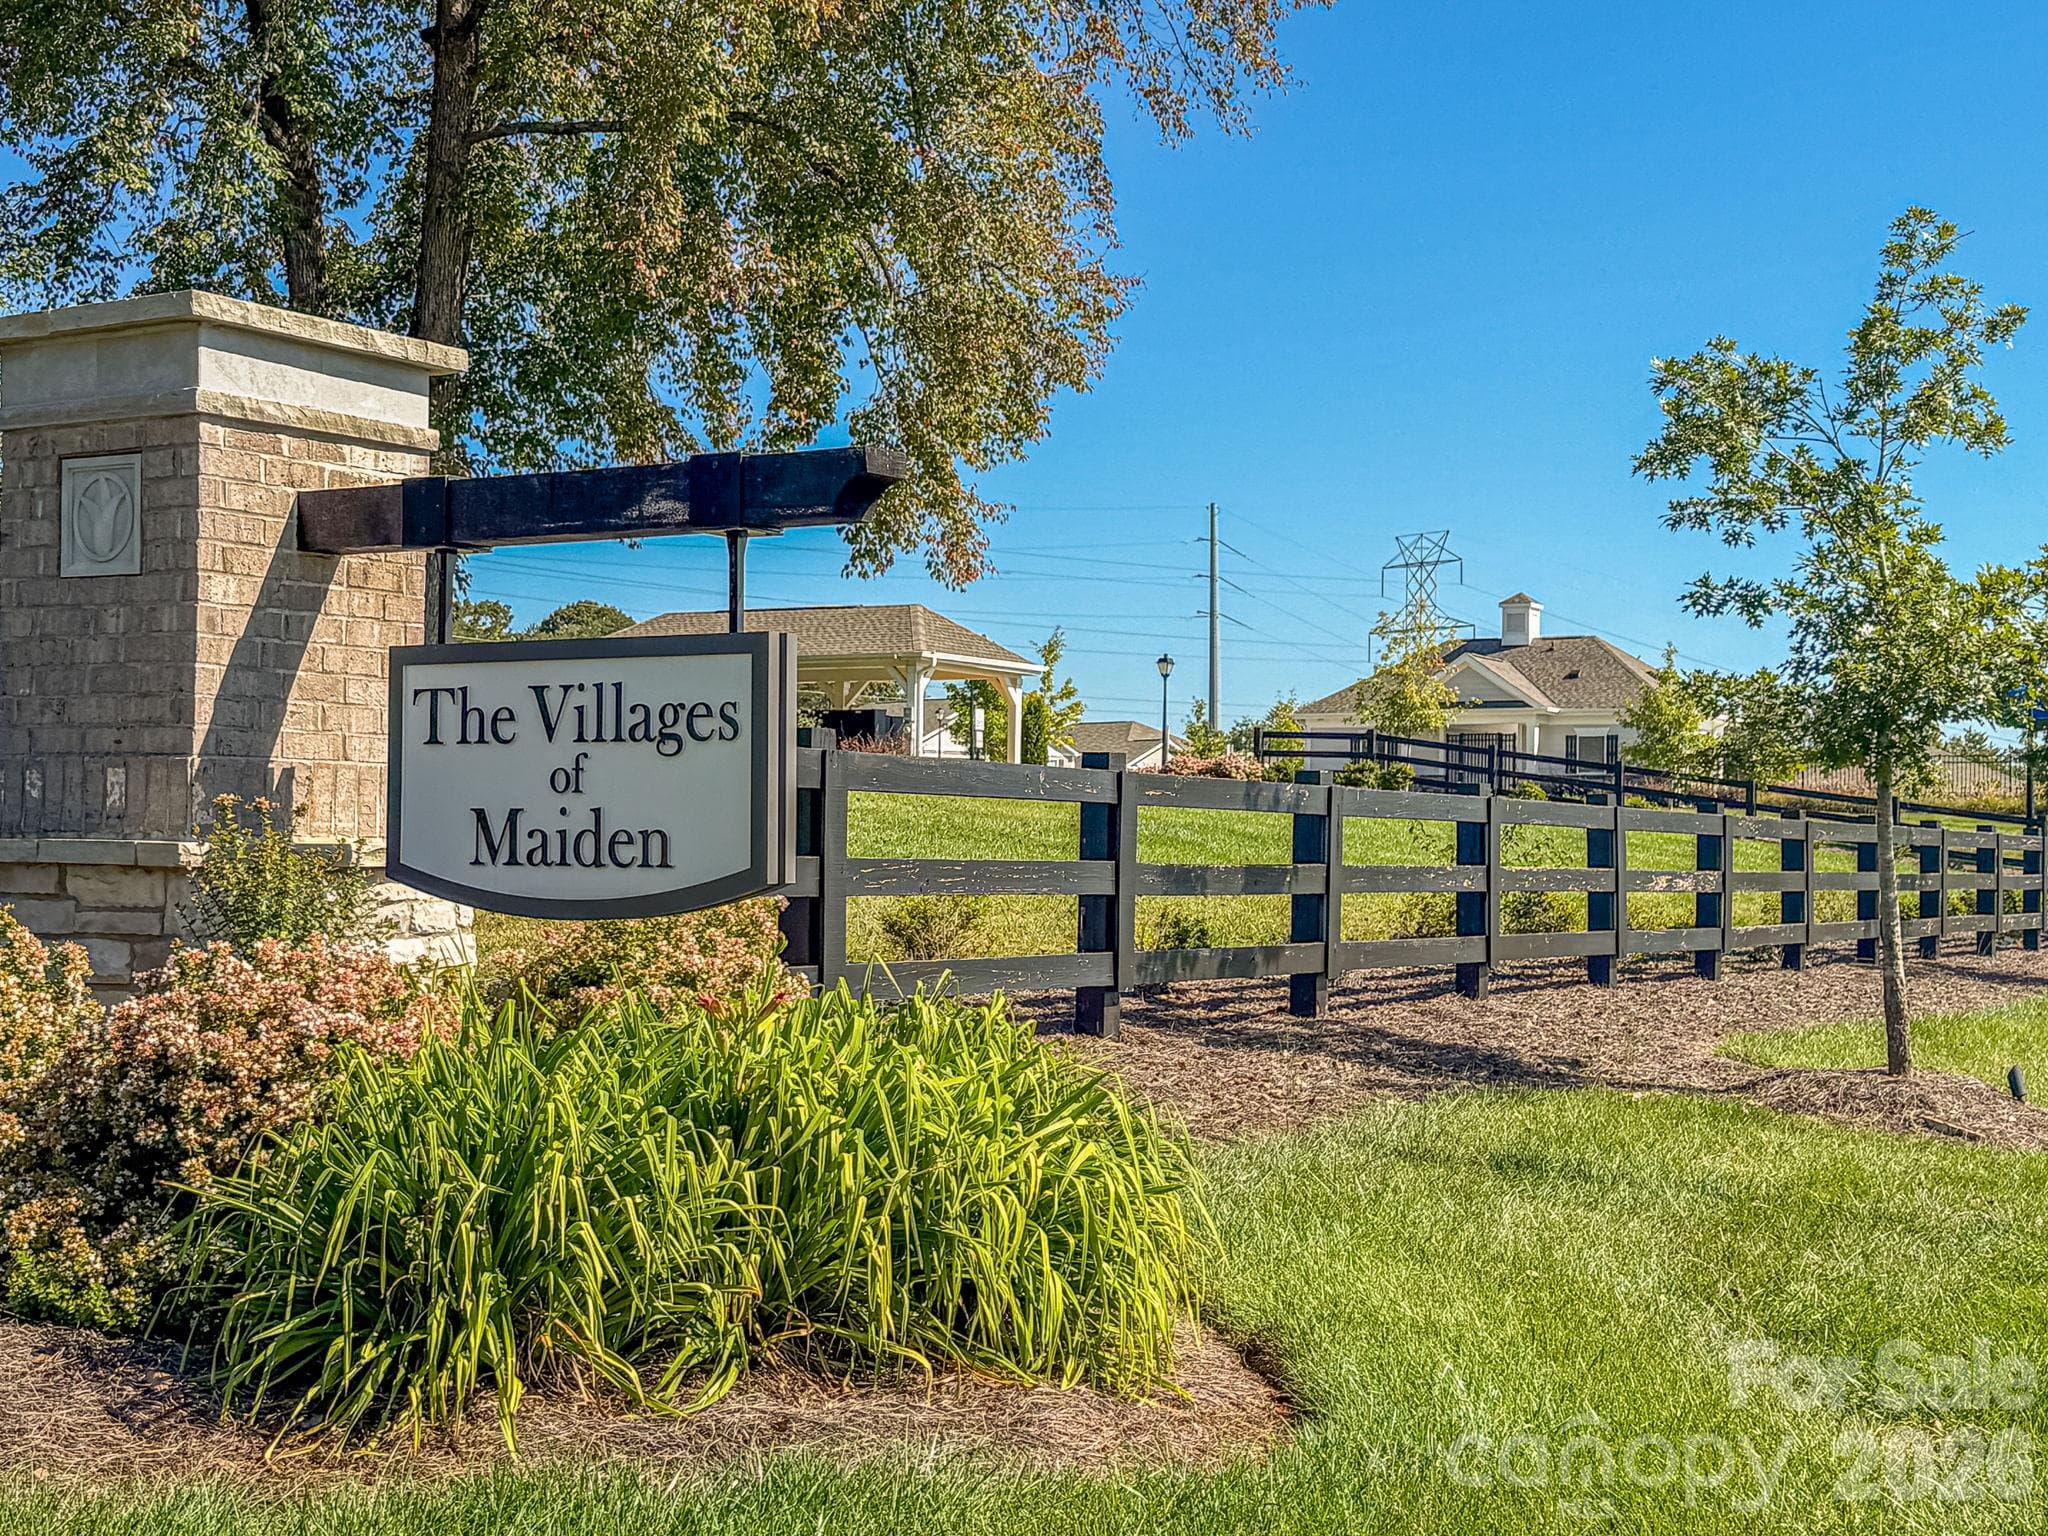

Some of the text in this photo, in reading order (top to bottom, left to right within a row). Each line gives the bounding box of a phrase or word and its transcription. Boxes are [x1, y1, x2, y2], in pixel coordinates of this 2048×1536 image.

[412, 681, 740, 757] The Villages
[549, 752, 589, 794] of
[469, 807, 675, 868] Maiden
